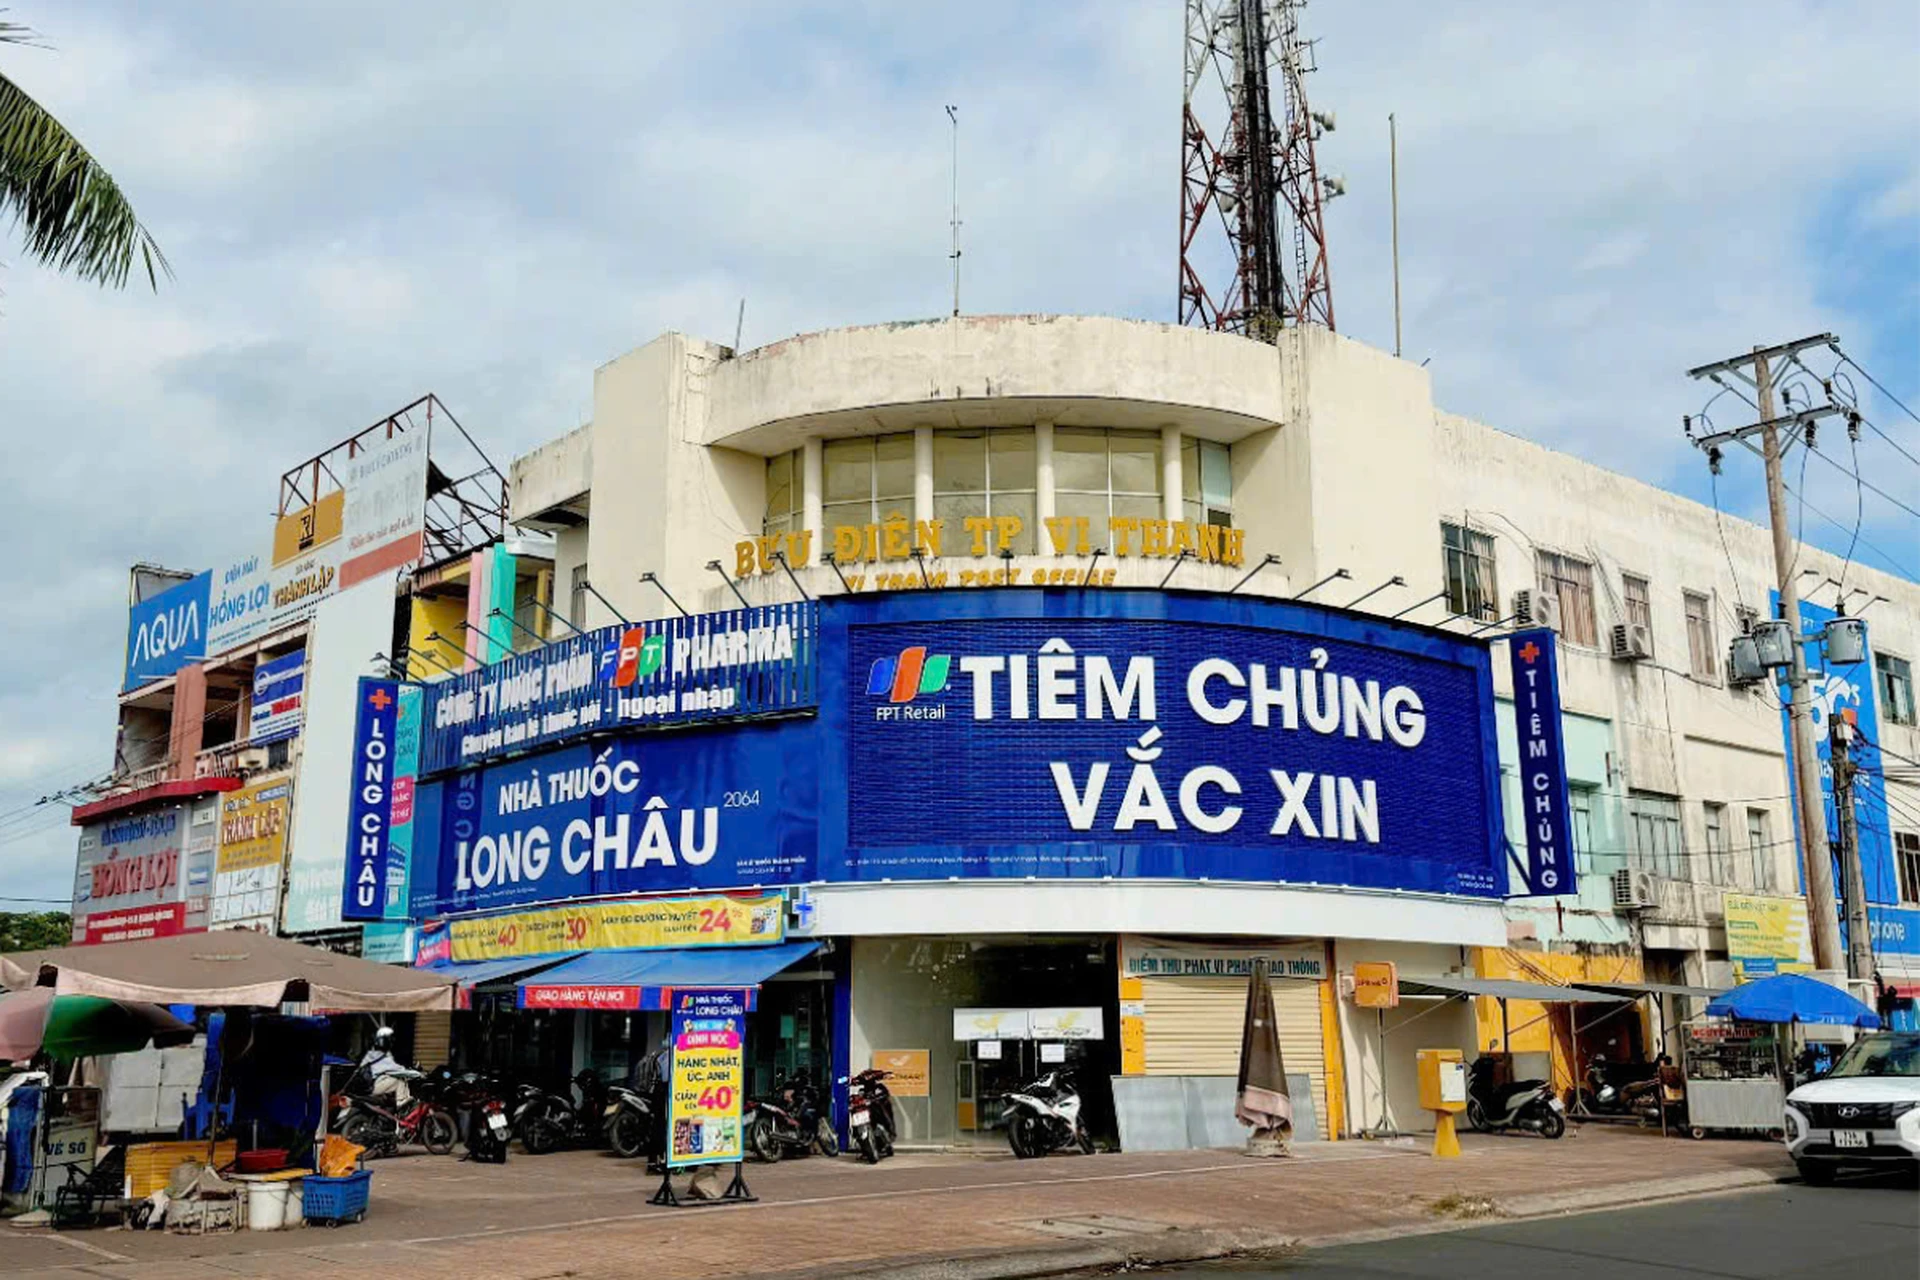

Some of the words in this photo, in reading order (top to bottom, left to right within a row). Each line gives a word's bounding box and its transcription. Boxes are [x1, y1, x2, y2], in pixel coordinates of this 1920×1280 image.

[964, 516, 1023, 555] TP
[959, 568, 1020, 587] POST
[132, 600, 199, 668] AQUA
[478, 682, 498, 718] TY
[674, 624, 793, 673] PHARMA
[618, 689, 676, 719] ngoại
[681, 684, 735, 713] nhập
[960, 637, 1156, 720] TIÊM
[1187, 647, 1426, 748] CHỦNG
[876, 706, 900, 720] FPT
[904, 703, 946, 720] Retail
[1526, 670, 1548, 758] TIÊM
[363, 718, 389, 805] LONG
[498, 769, 543, 814] NHÀ
[548, 747, 640, 804] THUỐC
[1049, 725, 1243, 833] VẮC
[1269, 768, 1380, 843] XIN
[723, 790, 760, 807] 2064
[1533, 772, 1558, 888] CHỦNG
[357, 813, 382, 907] CHÂU
[456, 825, 550, 890] LONG
[561, 796, 719, 875] CHÂU
[536, 989, 559, 1000] GIAO
[560, 987, 586, 1001] HÀNG
[1161, 959, 1181, 973] THU
[1214, 959, 1224, 974] VI
[1288, 957, 1321, 975] THÔNG
[695, 1006, 719, 1015] LONG
[720, 1004, 743, 1015] CHÂU
[707, 1071, 730, 1080] ANH
